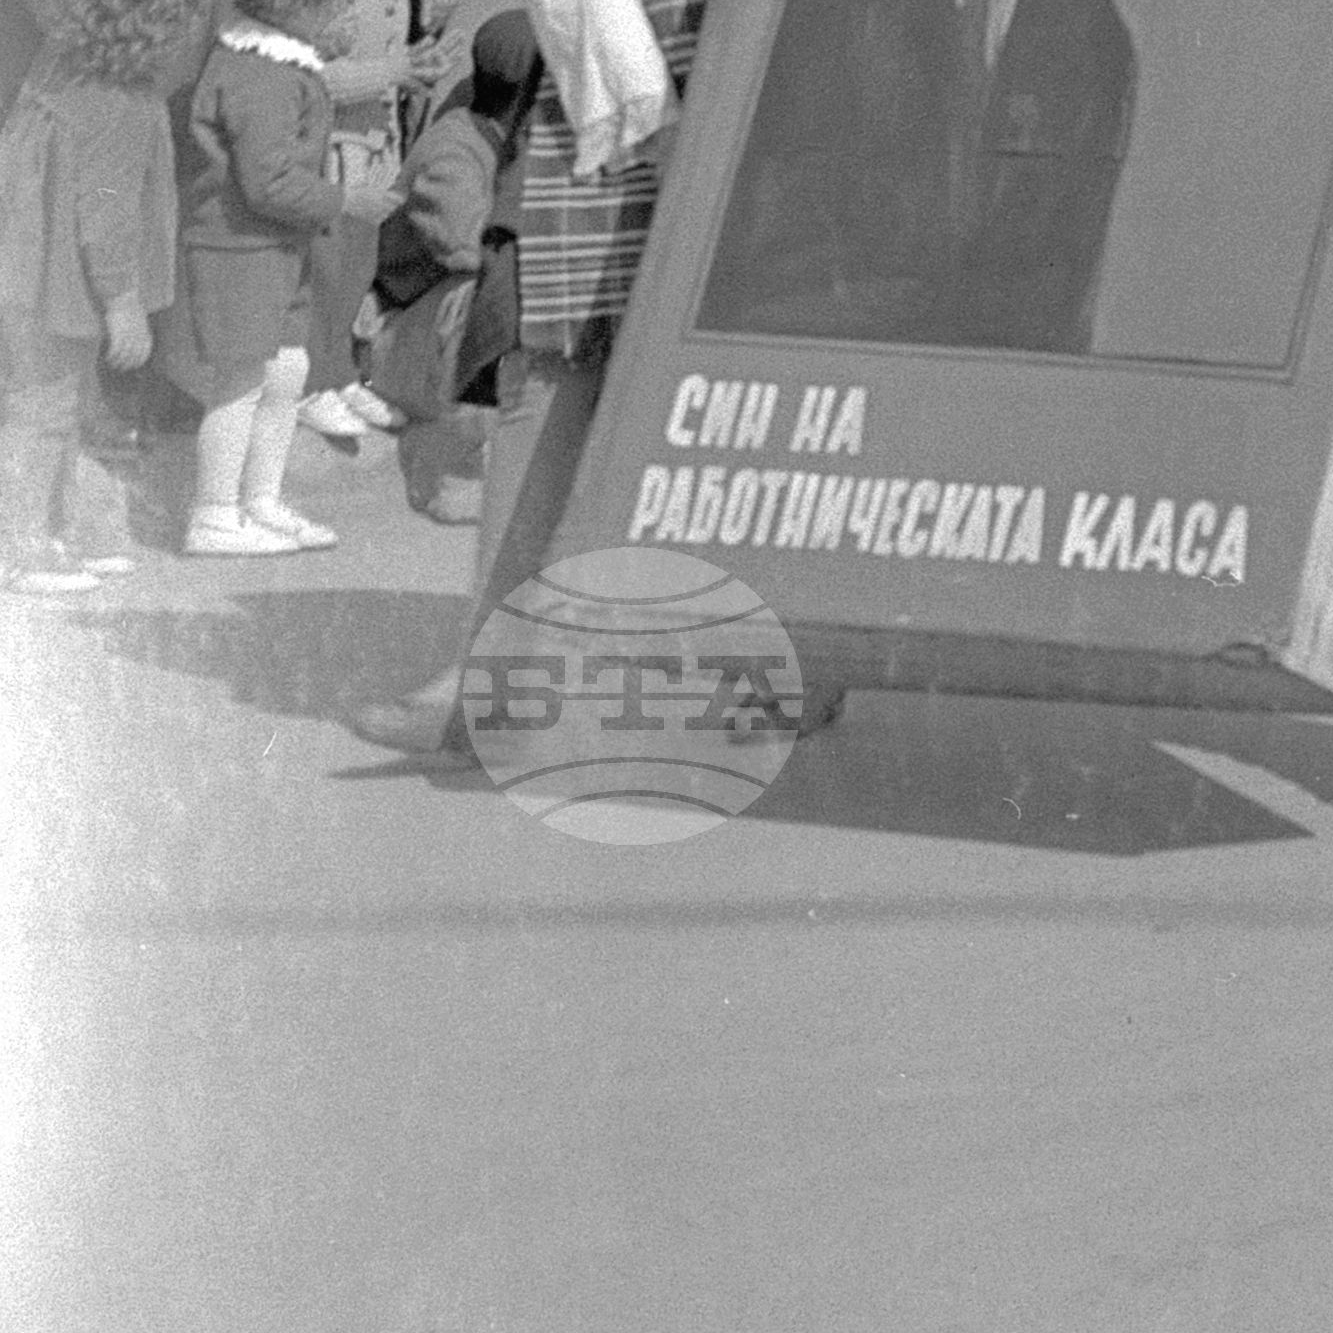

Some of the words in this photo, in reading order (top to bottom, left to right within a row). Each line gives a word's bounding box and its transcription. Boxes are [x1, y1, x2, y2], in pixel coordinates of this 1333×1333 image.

[665, 373, 779, 448] СИН
[790, 385, 868, 456] НА
[628, 464, 1045, 565] РАБОТНИЧЕСКАТА
[1058, 490, 1249, 583] КЛАСА
